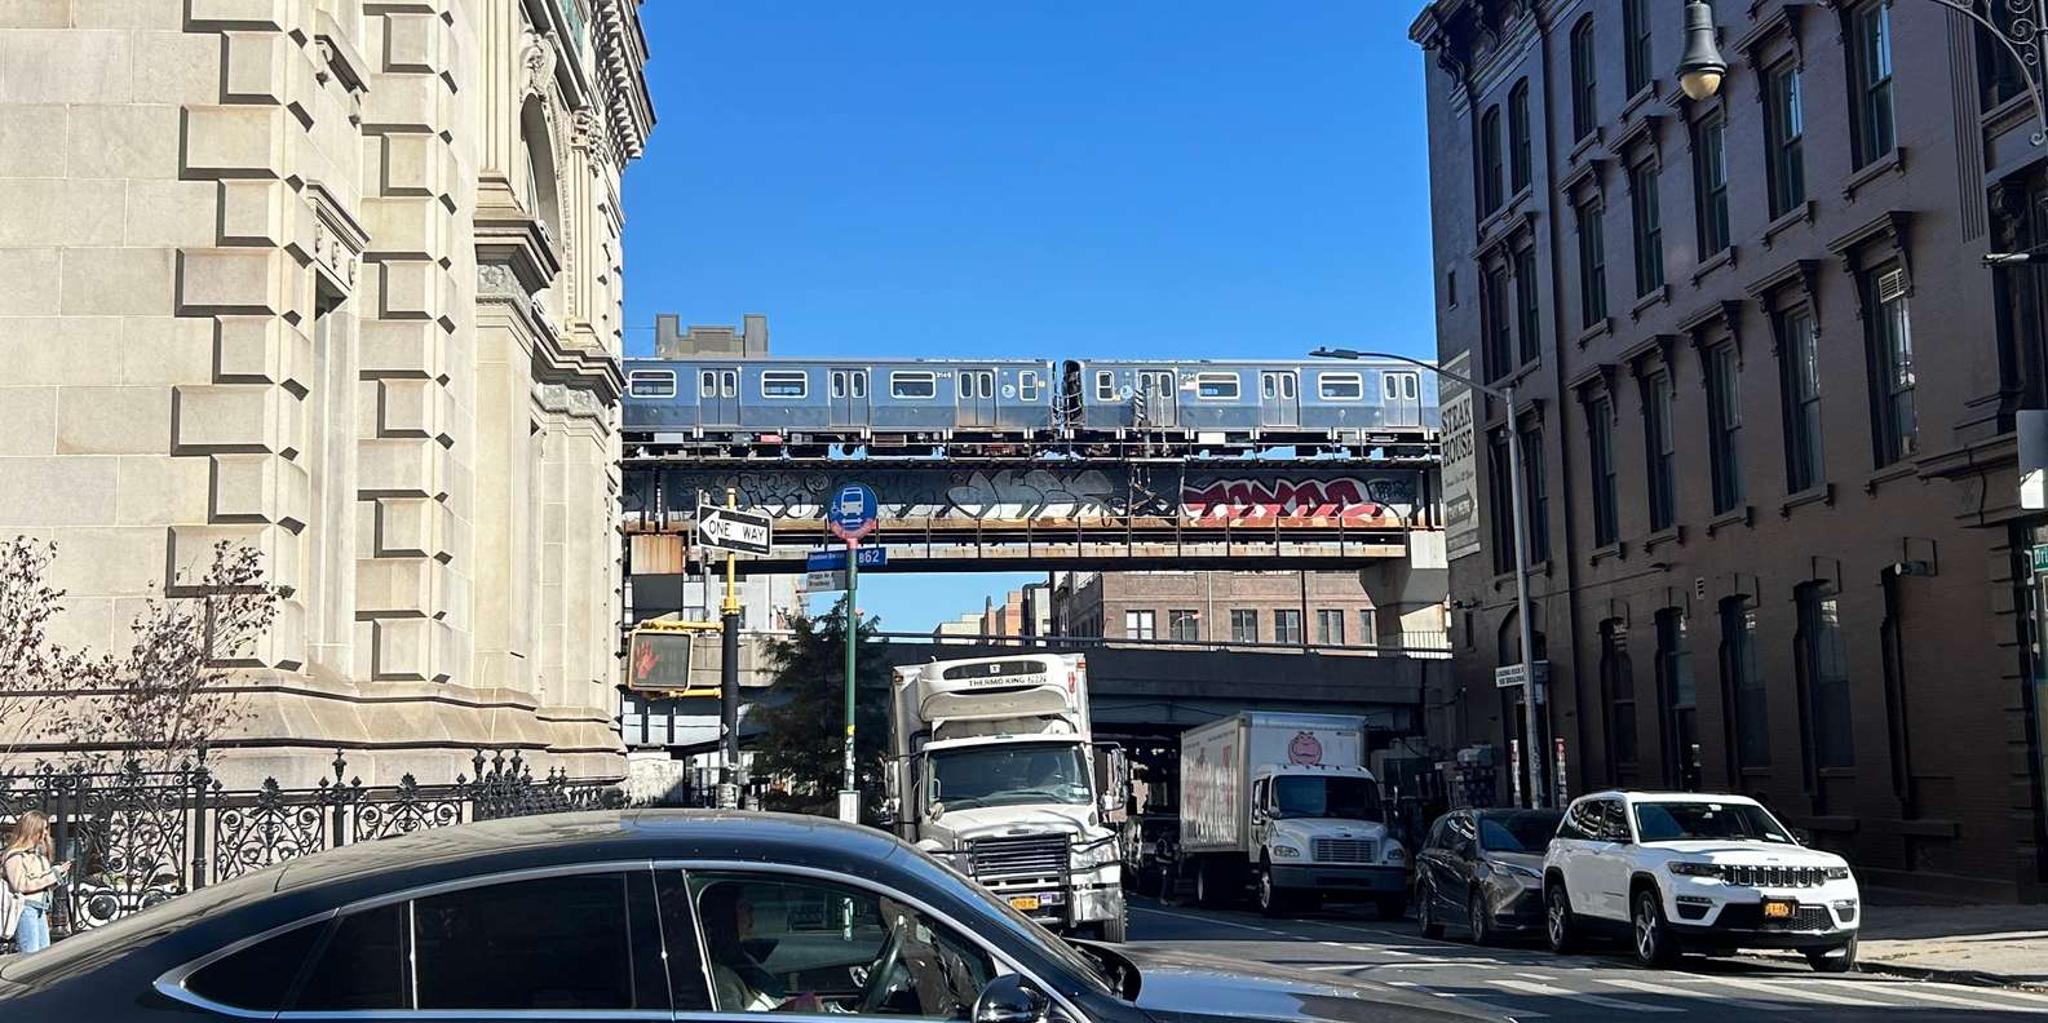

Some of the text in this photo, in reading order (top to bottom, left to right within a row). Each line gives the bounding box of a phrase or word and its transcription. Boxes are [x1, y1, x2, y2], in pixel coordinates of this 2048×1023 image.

[1442, 397, 1472, 437] STEAK
[1442, 428, 1473, 467] HOUSE
[709, 520, 766, 542] ONE WAY
[858, 549, 880, 563] B62
[969, 677, 1003, 687] THERMO
[1005, 675, 1025, 684] KING
